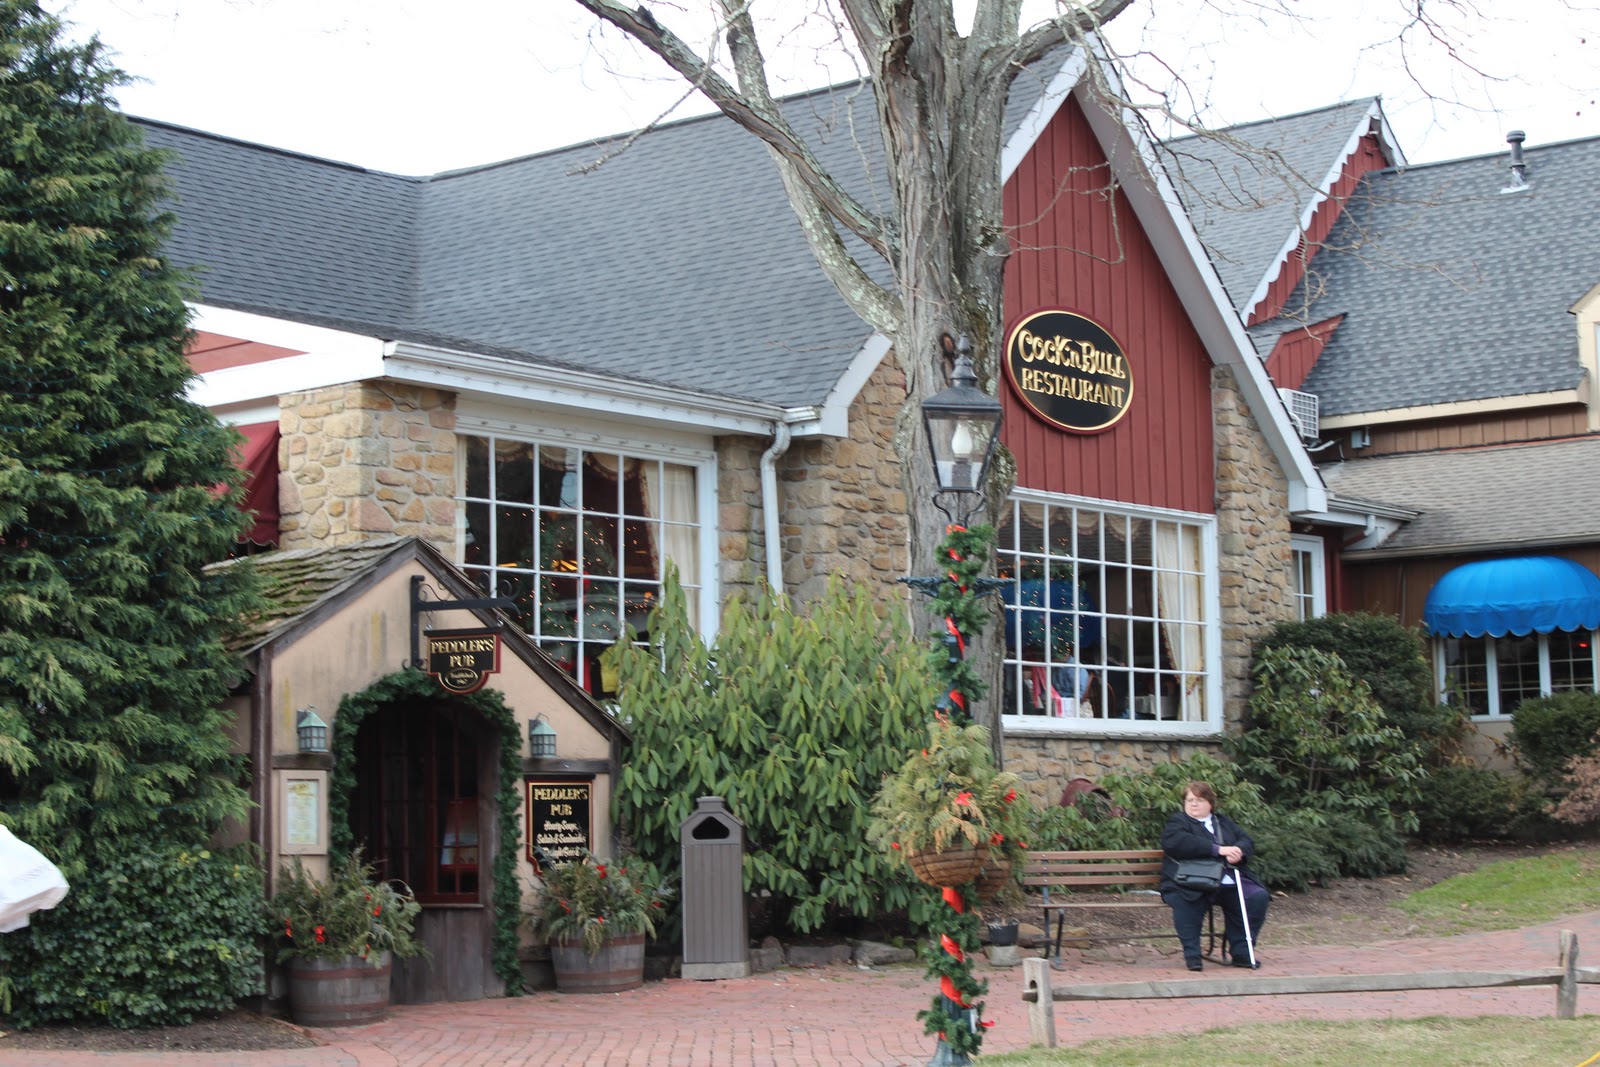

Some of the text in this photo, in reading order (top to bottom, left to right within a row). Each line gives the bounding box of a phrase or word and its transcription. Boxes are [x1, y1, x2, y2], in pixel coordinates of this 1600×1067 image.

[1021, 367, 1125, 408] RESTAURANT
[430, 639, 494, 654] PEDDLER'S
[449, 654, 475, 668] PUB
[534, 788, 588, 801] PEDDLER'S
[550, 804, 573, 816] PUB
